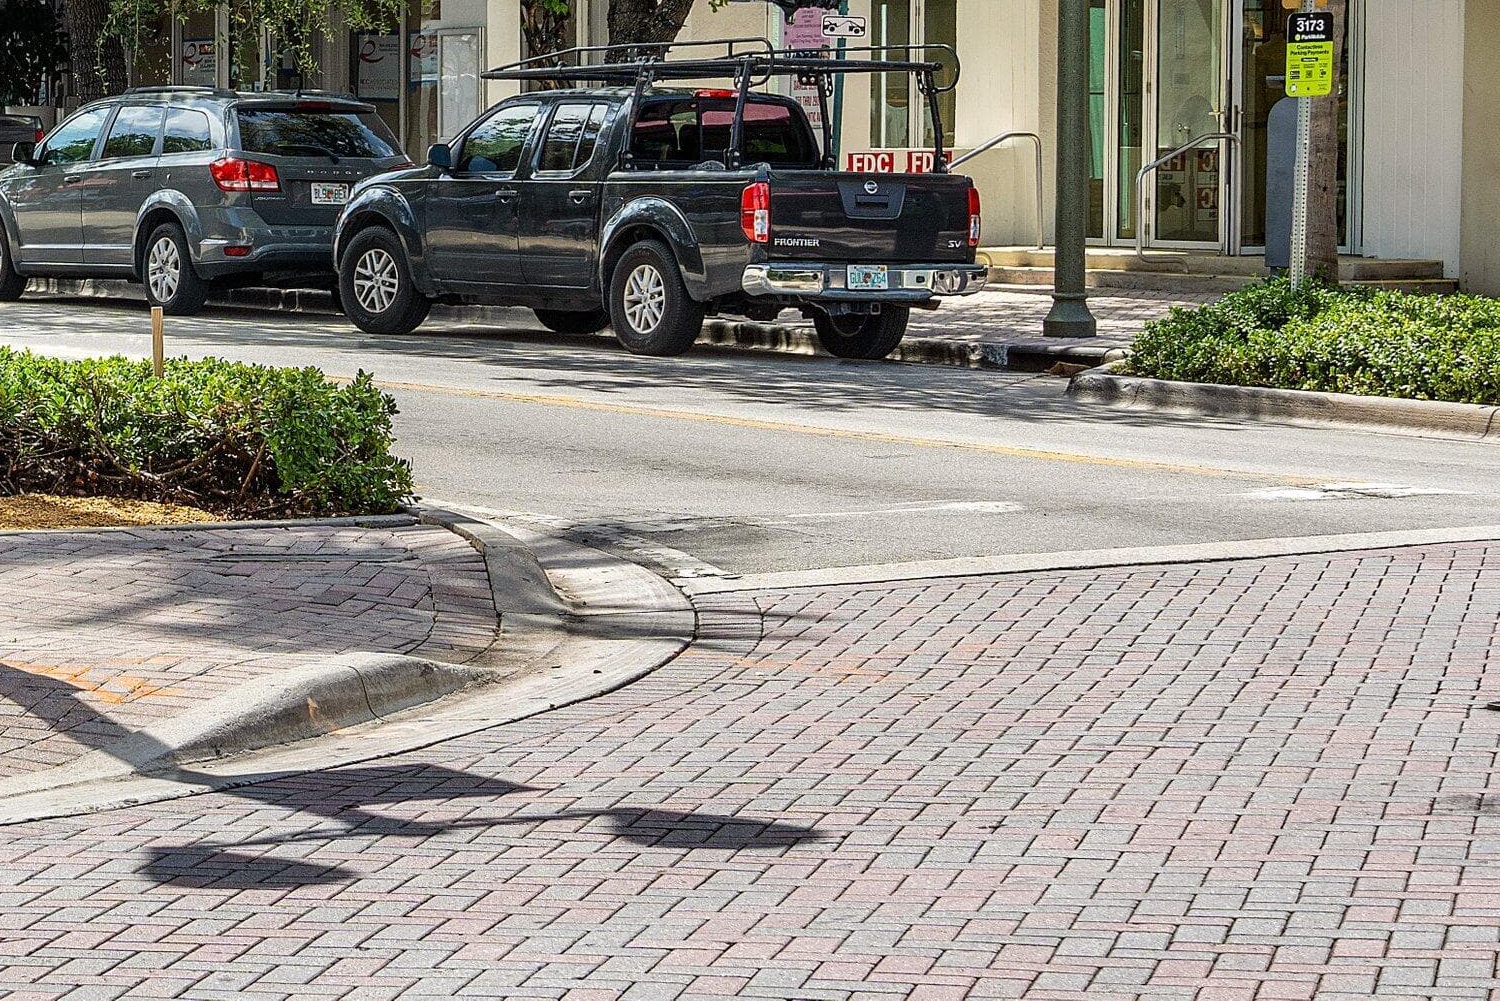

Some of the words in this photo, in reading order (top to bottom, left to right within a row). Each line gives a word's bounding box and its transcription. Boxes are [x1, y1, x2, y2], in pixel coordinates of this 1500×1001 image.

[1296, 19, 1325, 32] 3173
[911, 152, 940, 173] FD
[774, 237, 821, 248] FRONTIER
[947, 239, 962, 249] SV
